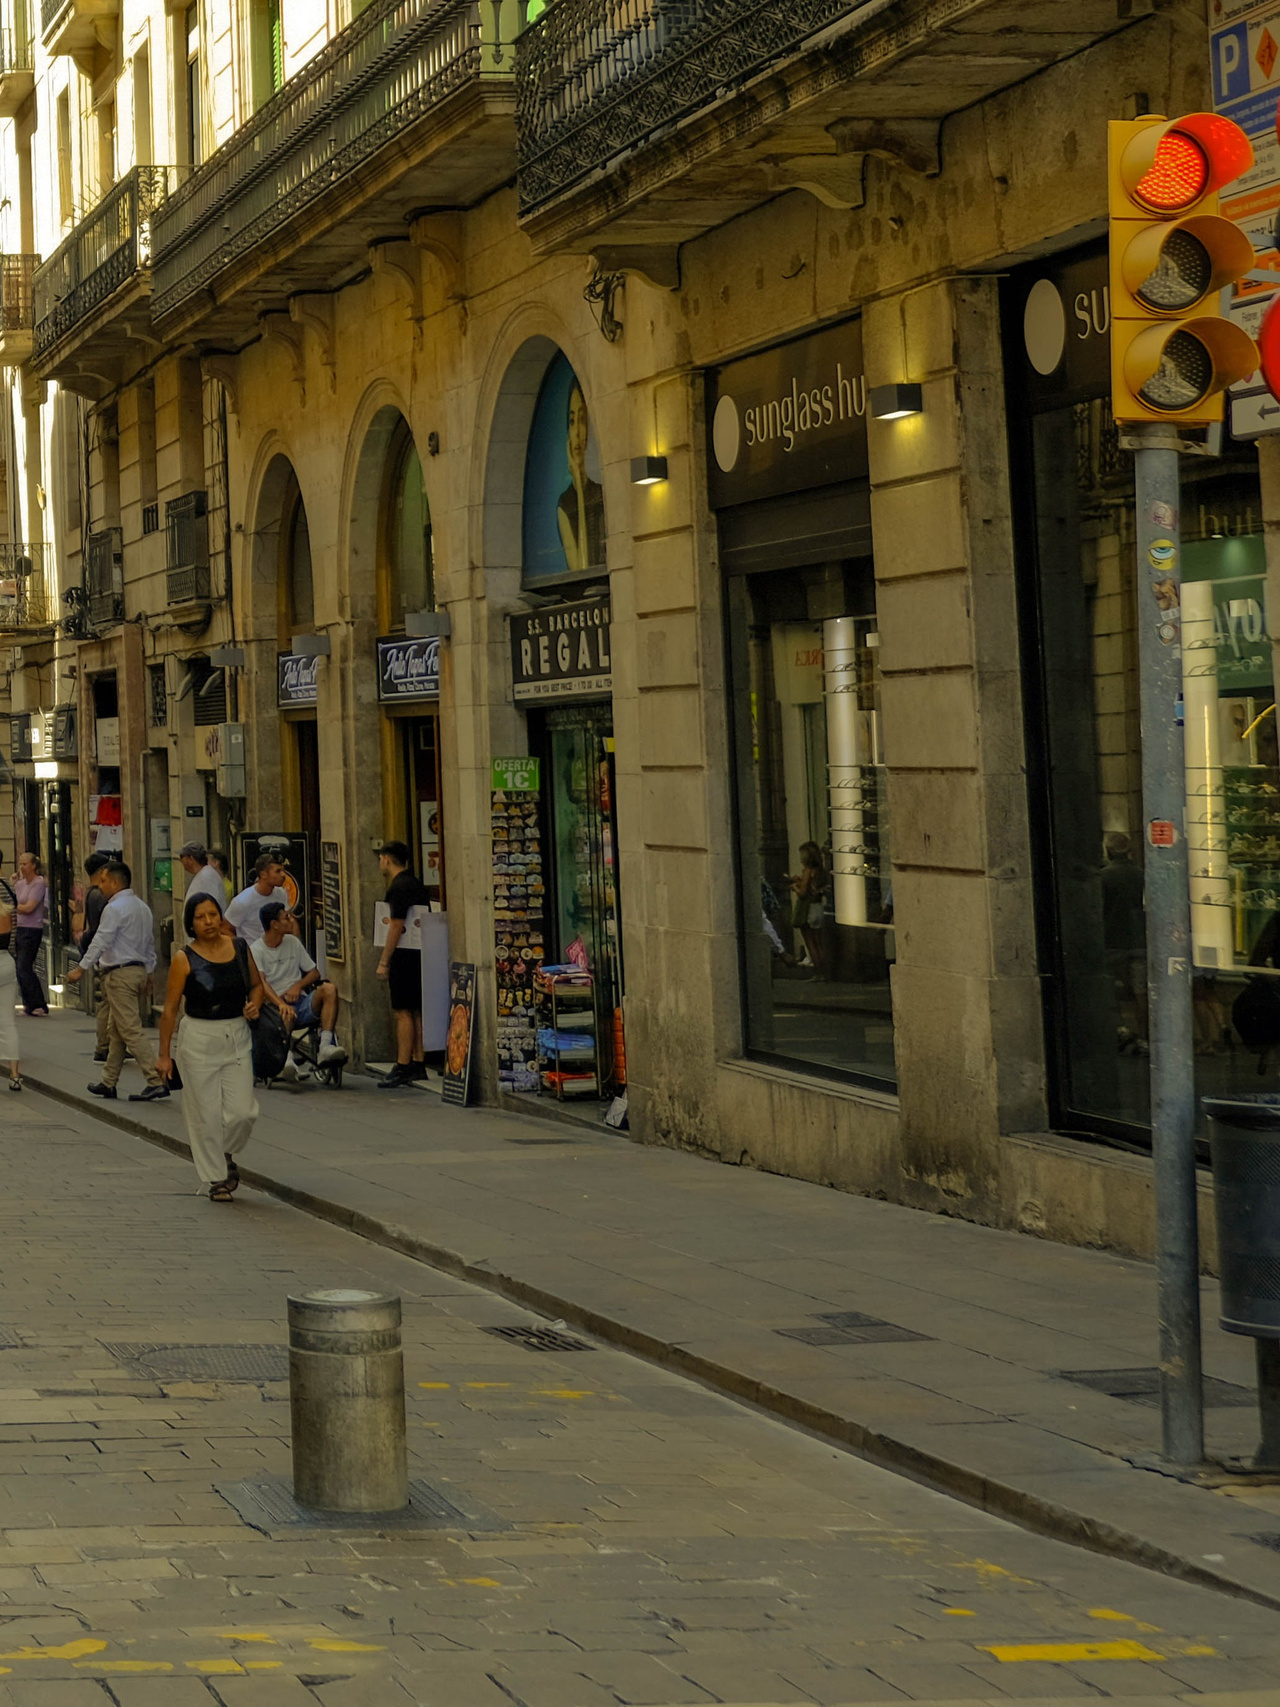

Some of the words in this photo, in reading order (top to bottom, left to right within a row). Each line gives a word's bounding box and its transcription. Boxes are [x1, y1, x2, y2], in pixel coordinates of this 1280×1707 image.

[1219, 33, 1239, 96] P
[745, 377, 834, 452] sunglass
[521, 628, 610, 676] REGAL
[494, 759, 535, 771] OFERTA
[503, 771, 529, 788] 1€
